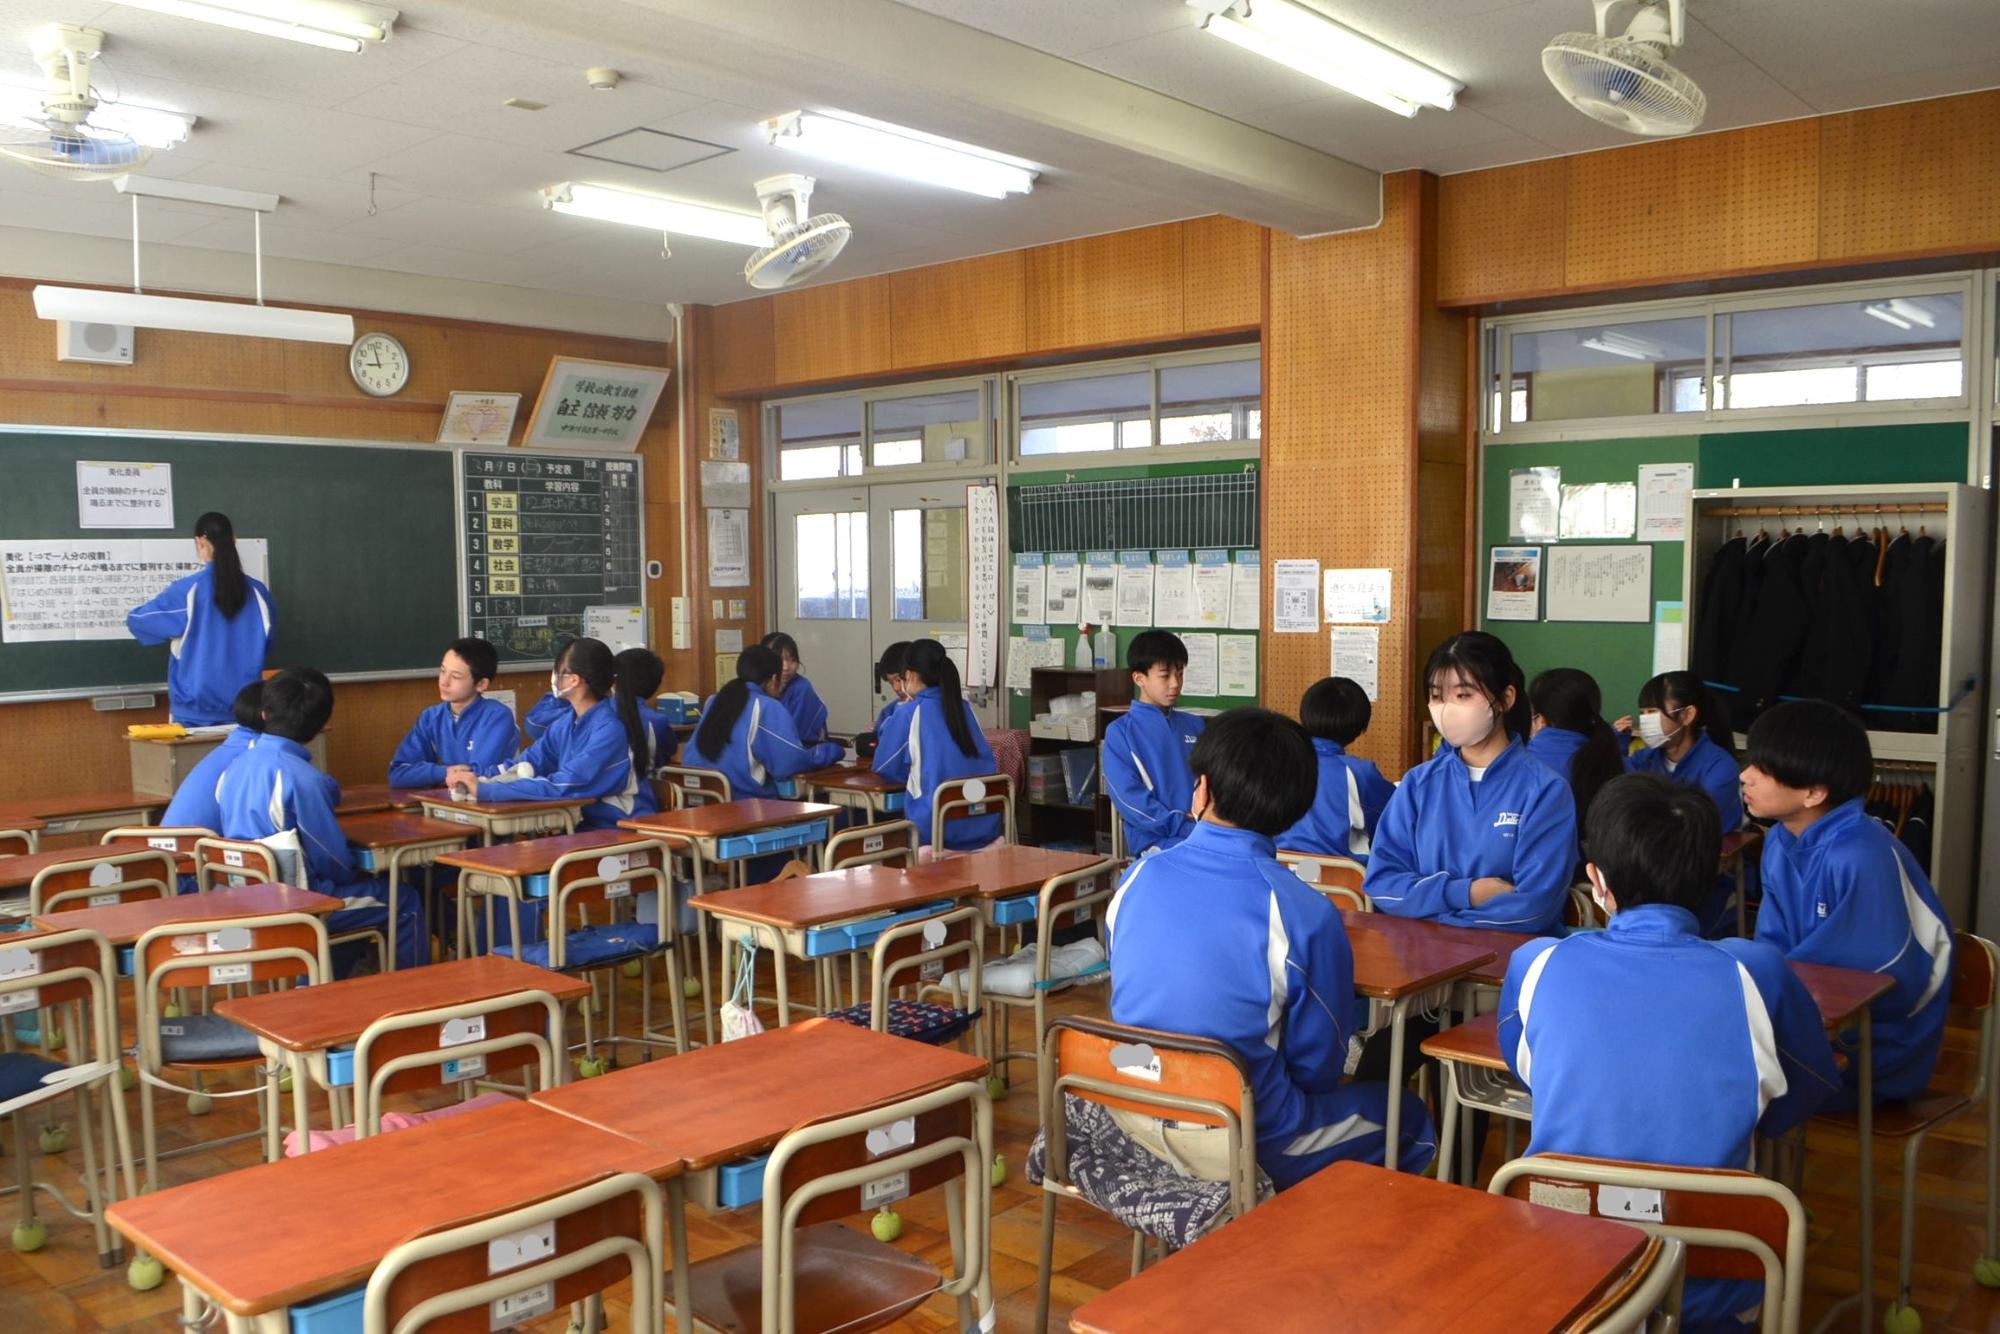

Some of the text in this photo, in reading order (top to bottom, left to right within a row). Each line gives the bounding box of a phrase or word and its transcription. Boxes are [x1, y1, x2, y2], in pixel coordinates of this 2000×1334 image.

[557, 398, 581, 416] 自主
[545, 481, 579, 493] 学習内容
[472, 496, 477, 508] 1
[472, 517, 480, 529] 2
[491, 517, 513, 530] 理科
[473, 538, 480, 550] 3
[492, 538, 514, 551] 数学
[474, 560, 480, 571] 4
[493, 560, 515, 572] 社会
[475, 581, 481, 592] 5
[494, 580, 515, 592] 英語
[475, 602, 482, 613] 6
